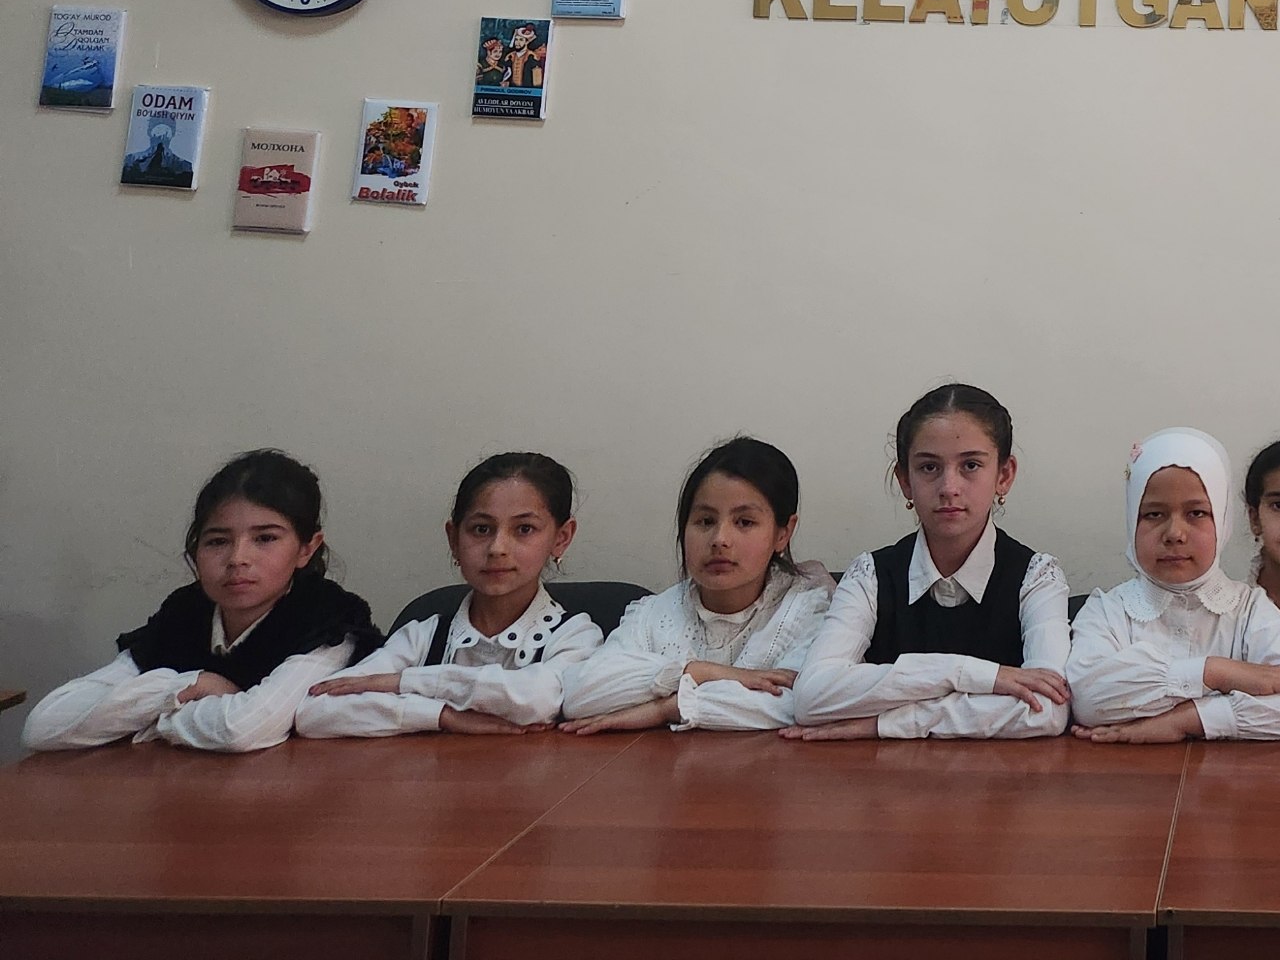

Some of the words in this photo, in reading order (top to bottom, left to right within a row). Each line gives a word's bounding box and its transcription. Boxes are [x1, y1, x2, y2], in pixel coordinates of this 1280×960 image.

[142, 93, 194, 111] ODAM
[250, 142, 305, 153] МОЛХОНА
[357, 187, 418, 202] Bolalik
